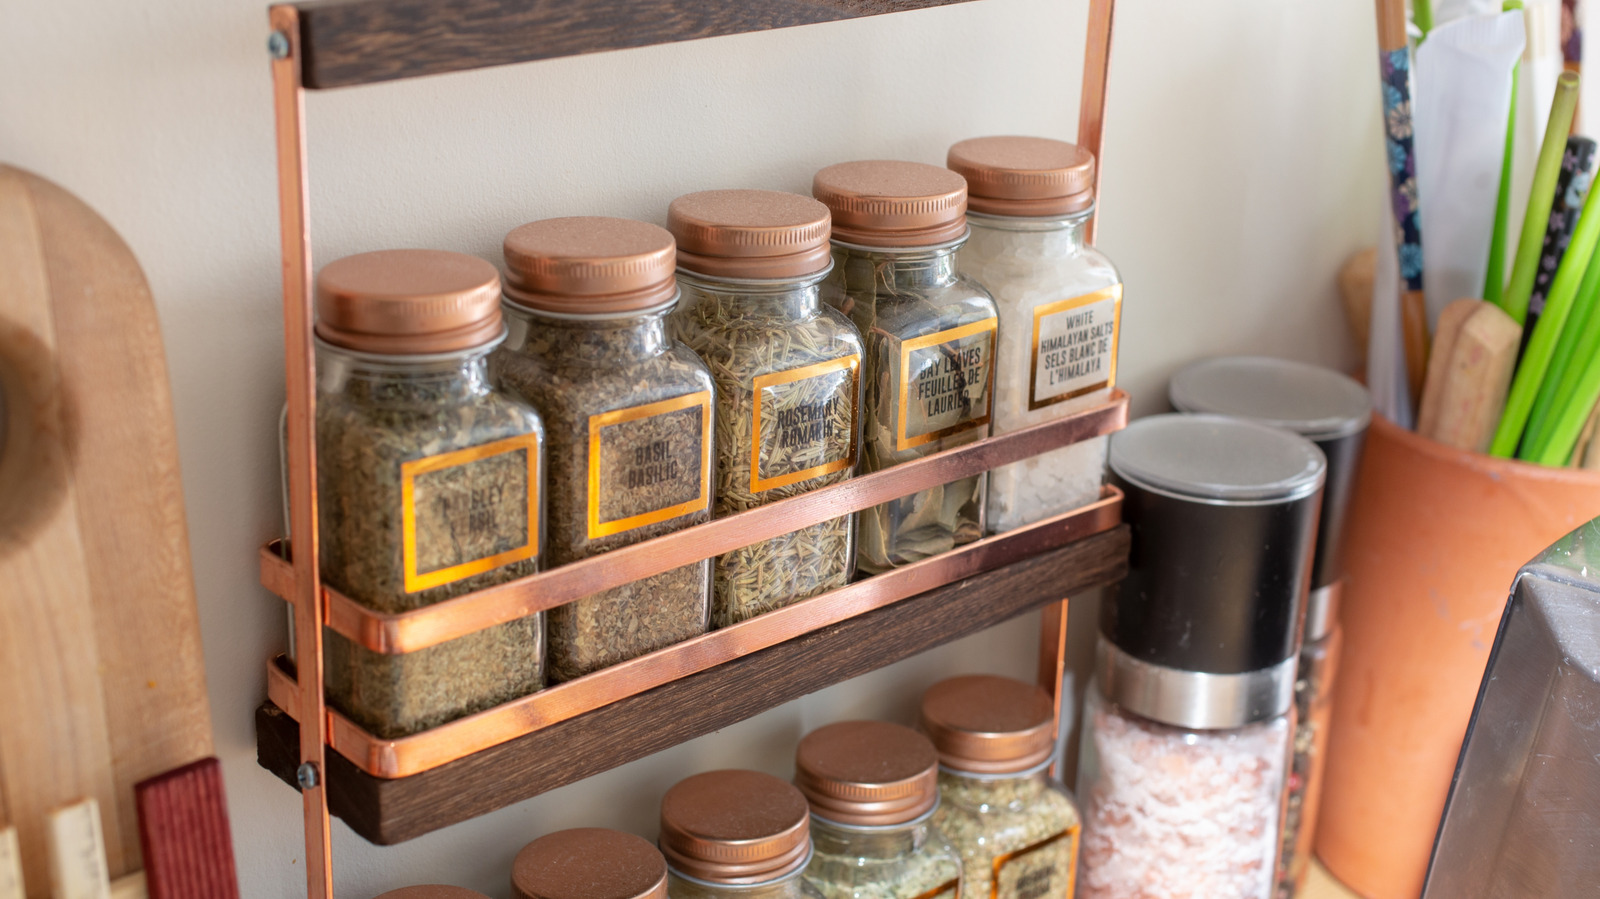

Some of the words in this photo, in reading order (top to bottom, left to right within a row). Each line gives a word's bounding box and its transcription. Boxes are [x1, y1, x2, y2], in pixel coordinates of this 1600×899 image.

[1066, 310, 1094, 330] WHITE
[1041, 328, 1089, 354] HIMALAYAN
[1091, 321, 1114, 340] SALTS
[944, 347, 981, 373] LEAVES
[1045, 350, 1067, 370] SELS
[1069, 342, 1096, 363] BLANC
[1098, 338, 1109, 354] DE
[968, 367, 981, 386] DE
[1049, 357, 1101, 385] L'HIMALAYA
[777, 397, 839, 429] ROSEMARY
[928, 389, 970, 417] LAURIER
[782, 418, 834, 448] ROMARIN
[635, 441, 671, 466] BASIL
[628, 459, 678, 489] BASILIC
